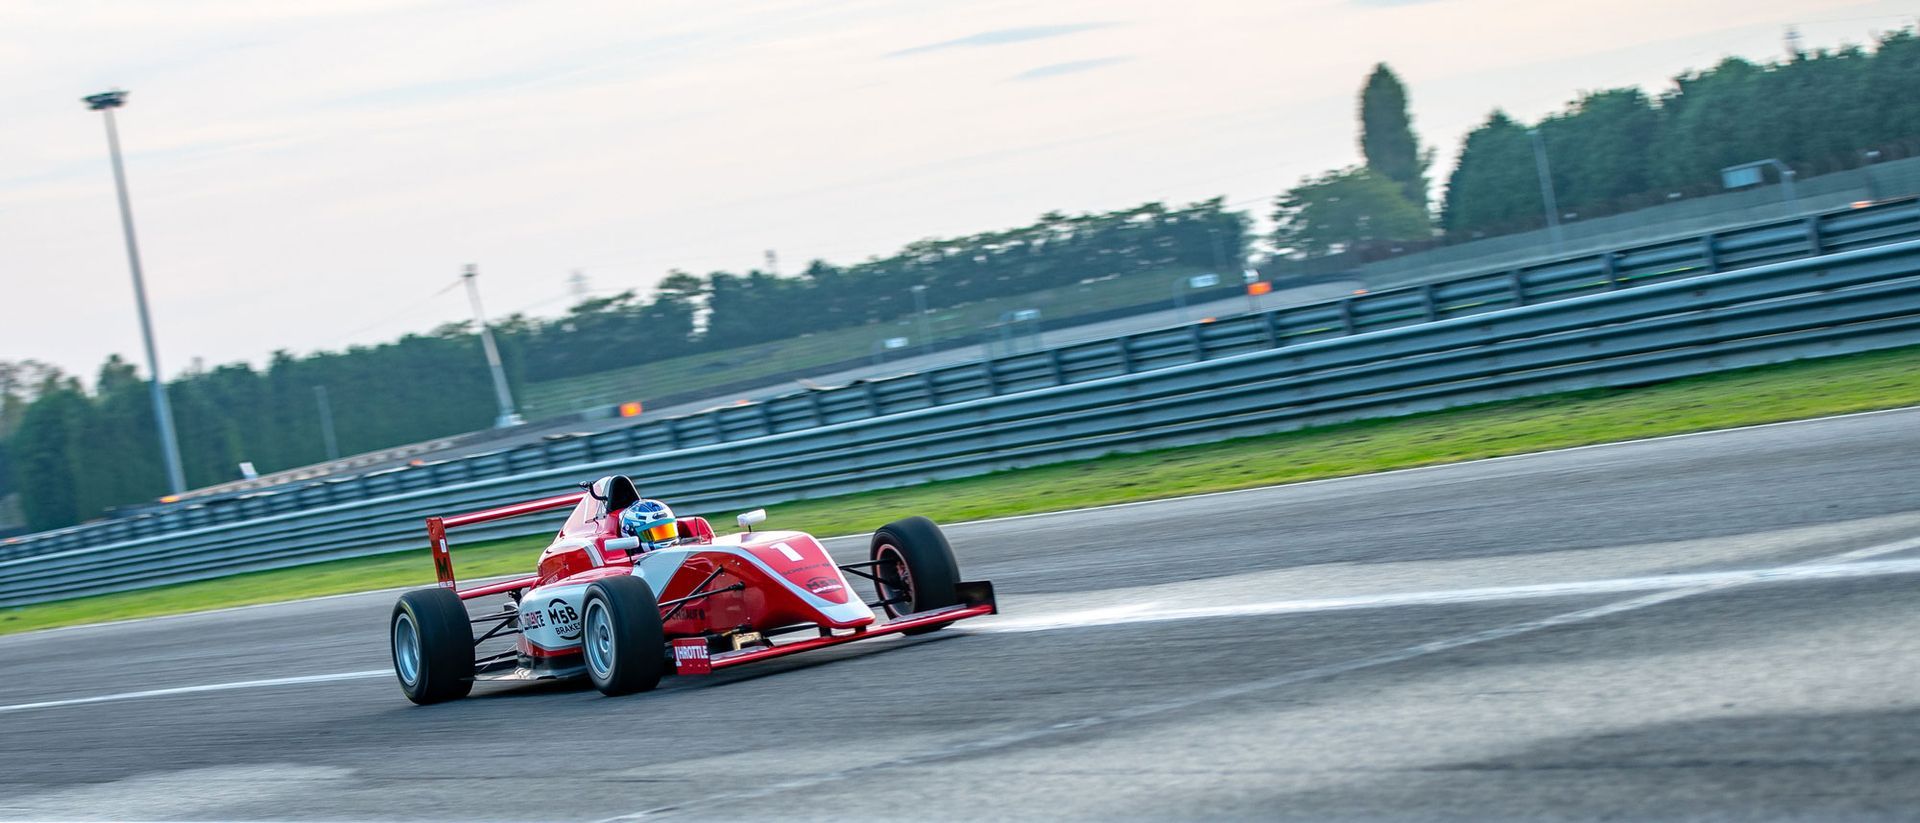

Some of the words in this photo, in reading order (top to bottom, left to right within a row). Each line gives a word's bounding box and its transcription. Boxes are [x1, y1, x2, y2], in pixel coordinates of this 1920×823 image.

[769, 542, 804, 562] 1
[548, 606, 578, 625] M5B
[674, 645, 709, 667] THROTTLE
